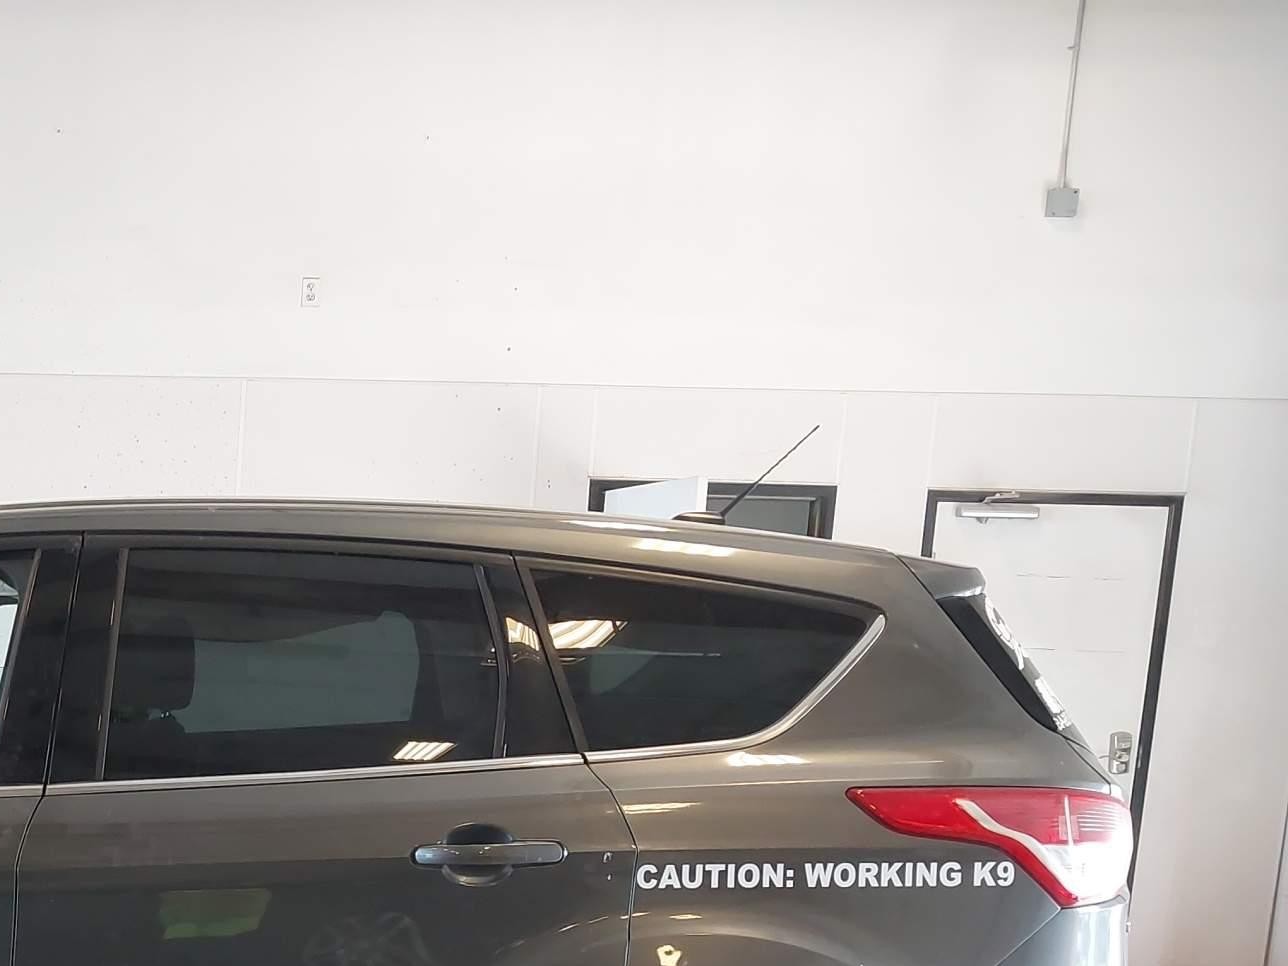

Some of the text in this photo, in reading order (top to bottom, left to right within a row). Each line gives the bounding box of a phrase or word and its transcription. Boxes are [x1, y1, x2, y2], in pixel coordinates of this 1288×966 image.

[636, 861, 1015, 890] CAUTION: WORKING K9
